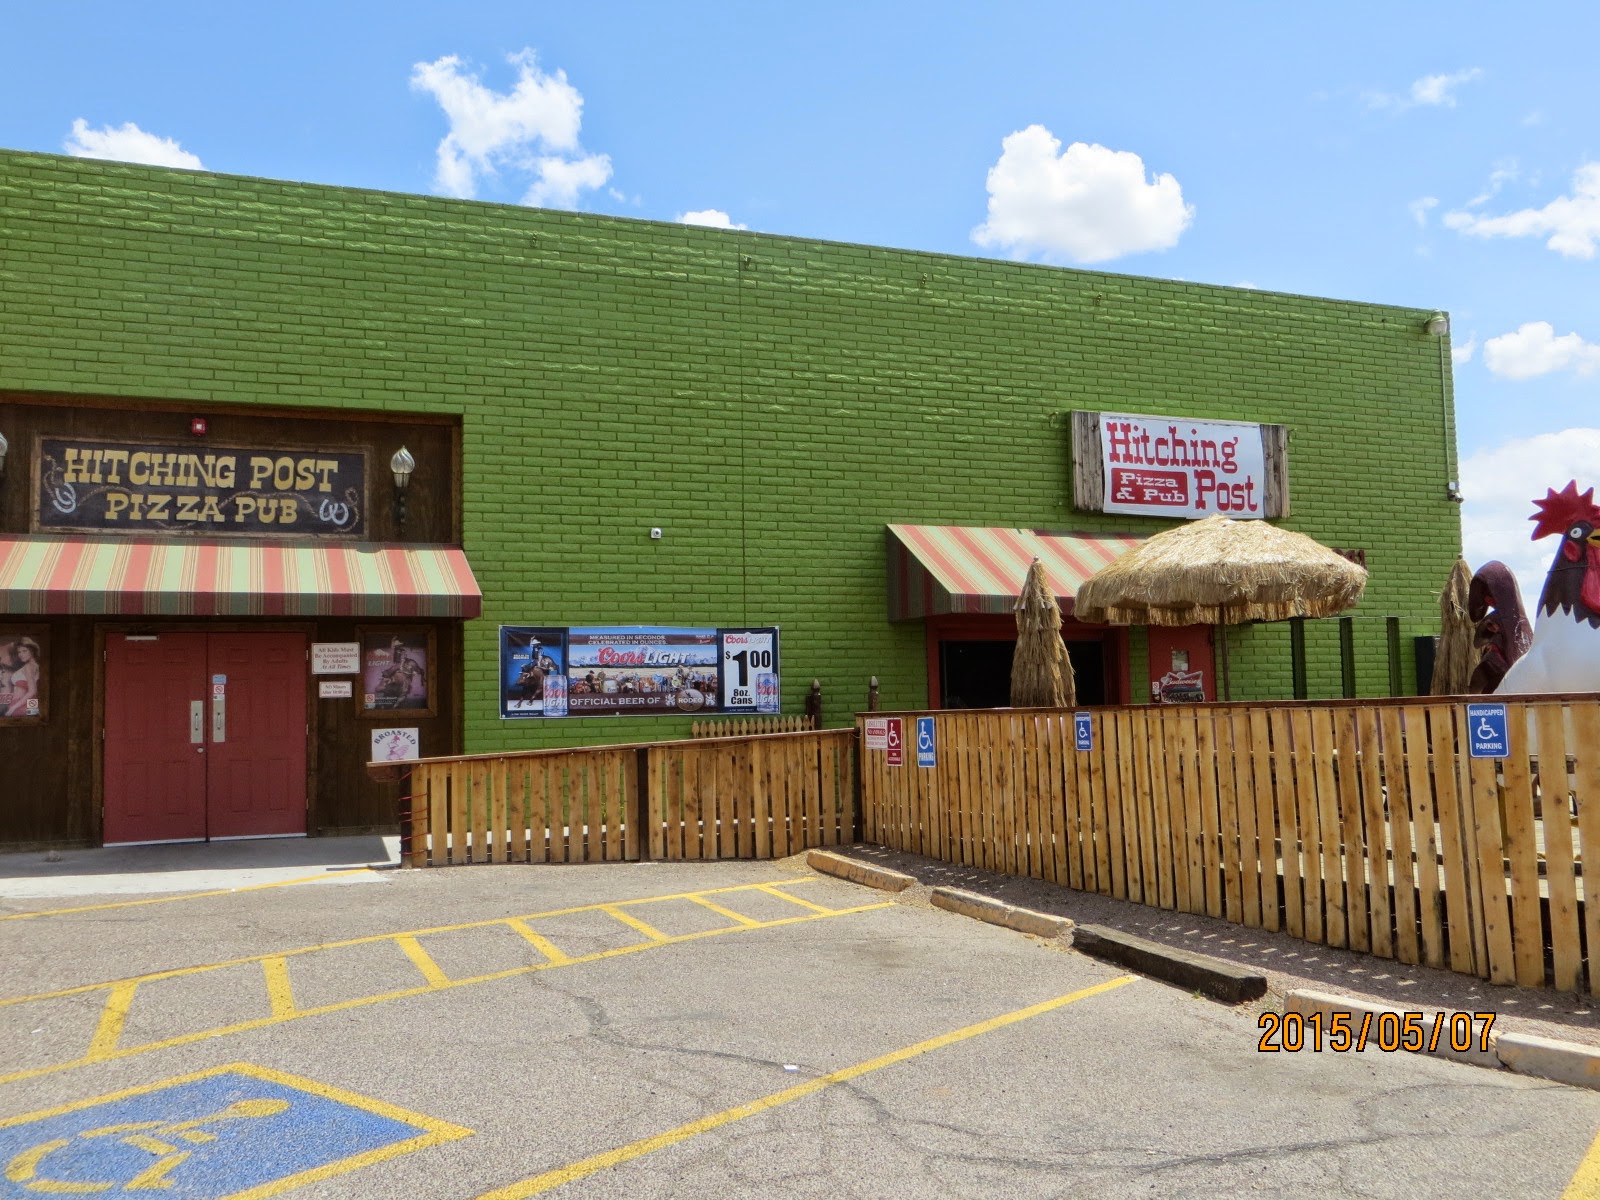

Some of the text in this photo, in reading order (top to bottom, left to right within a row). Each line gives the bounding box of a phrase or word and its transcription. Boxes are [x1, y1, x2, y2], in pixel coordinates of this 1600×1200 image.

[1106, 422, 1239, 474] Hitching
[64, 448, 338, 493] HITCHING POST
[1120, 472, 1178, 488] Pizza
[1143, 488, 1185, 503] Pub
[1194, 469, 1258, 512] Post
[105, 493, 298, 524] PIZZA PUB
[725, 634, 748, 644] Coors
[598, 646, 689, 665] Coors LIGHT
[570, 698, 617, 706] OFFICIAL
[618, 697, 646, 705] BEER
[374, 730, 417, 745] BROASTED
